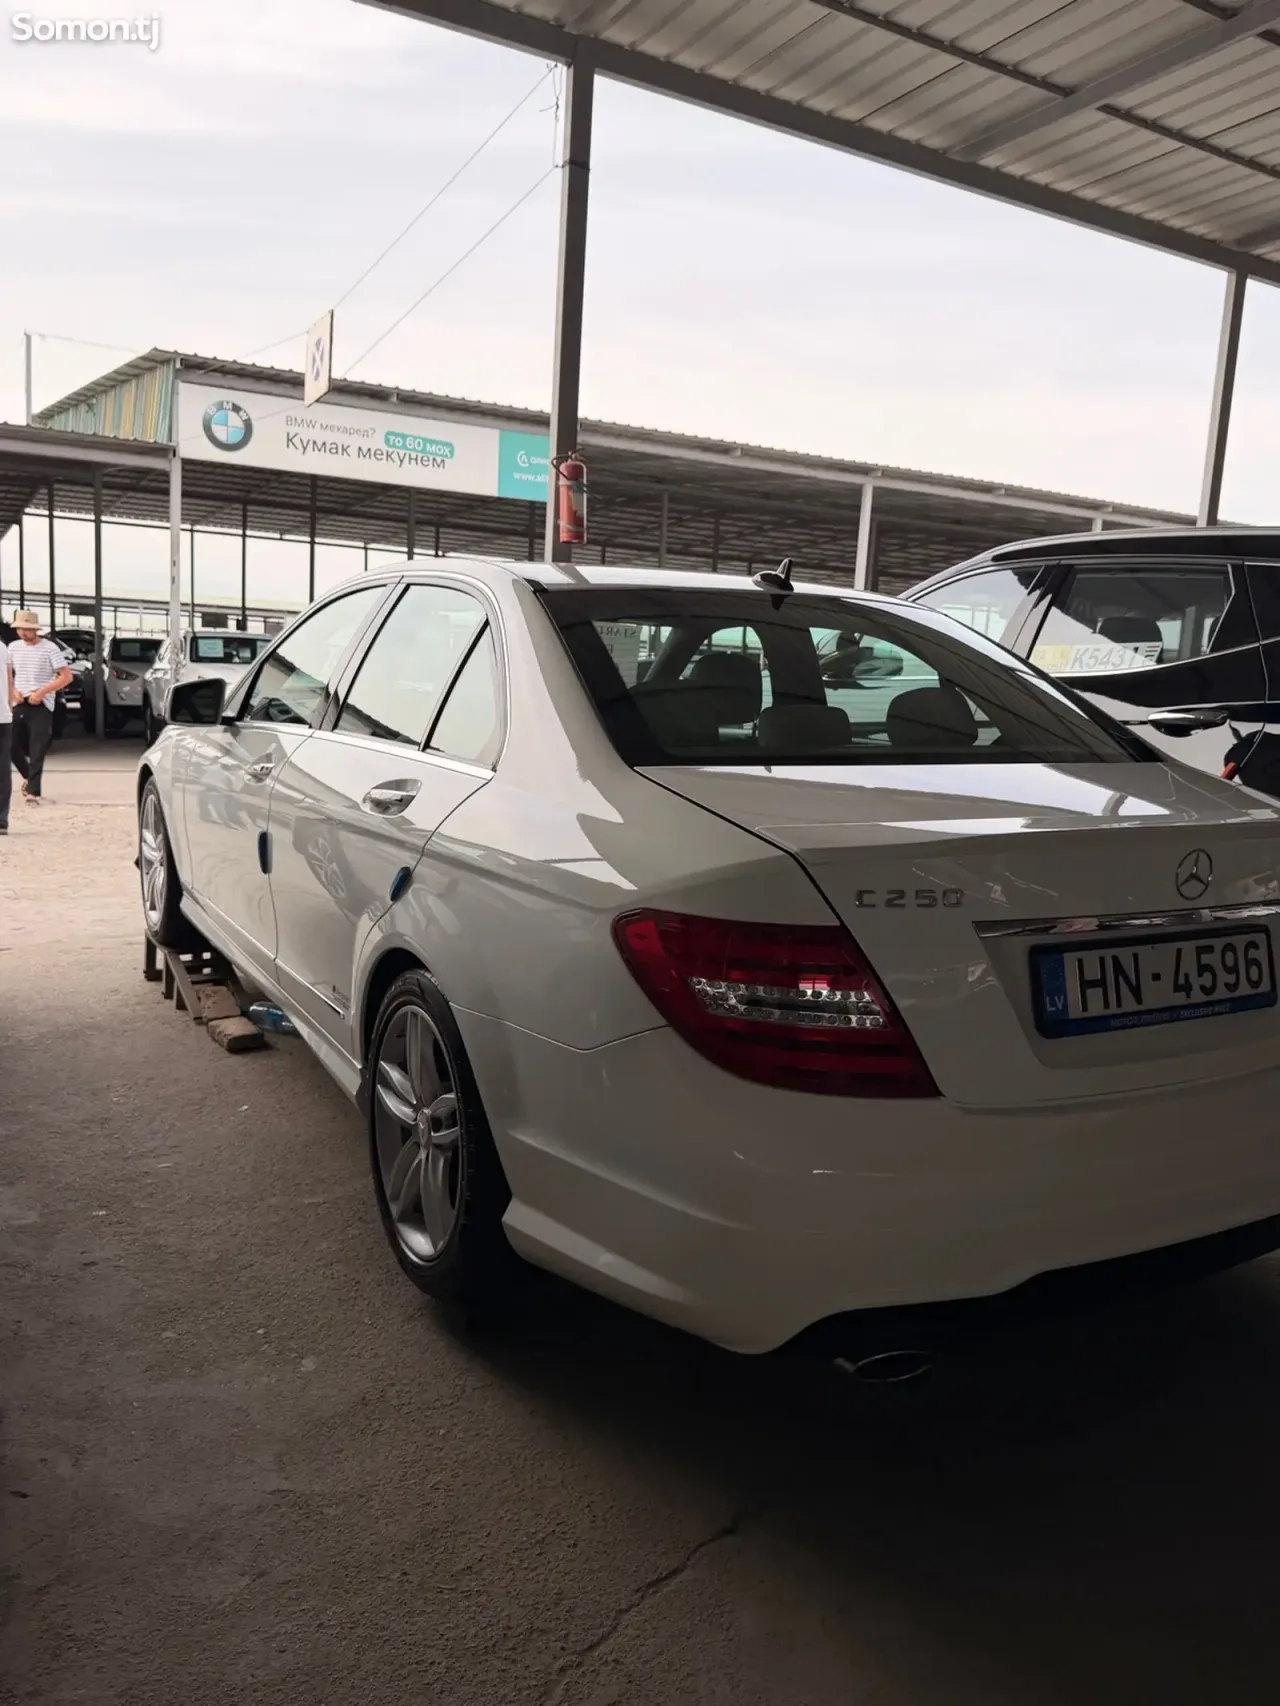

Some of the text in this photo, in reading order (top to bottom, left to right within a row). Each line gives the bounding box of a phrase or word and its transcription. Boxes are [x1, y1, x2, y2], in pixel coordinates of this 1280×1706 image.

[207, 400, 249, 420] BMW
[285, 415, 377, 439] BMW мехаред?
[286, 431, 446, 469] Кумак мекунем
[387, 434, 453, 458] то 60 мох
[1075, 940, 1264, 1013] HN-4596
[1046, 995, 1064, 1012] LV
